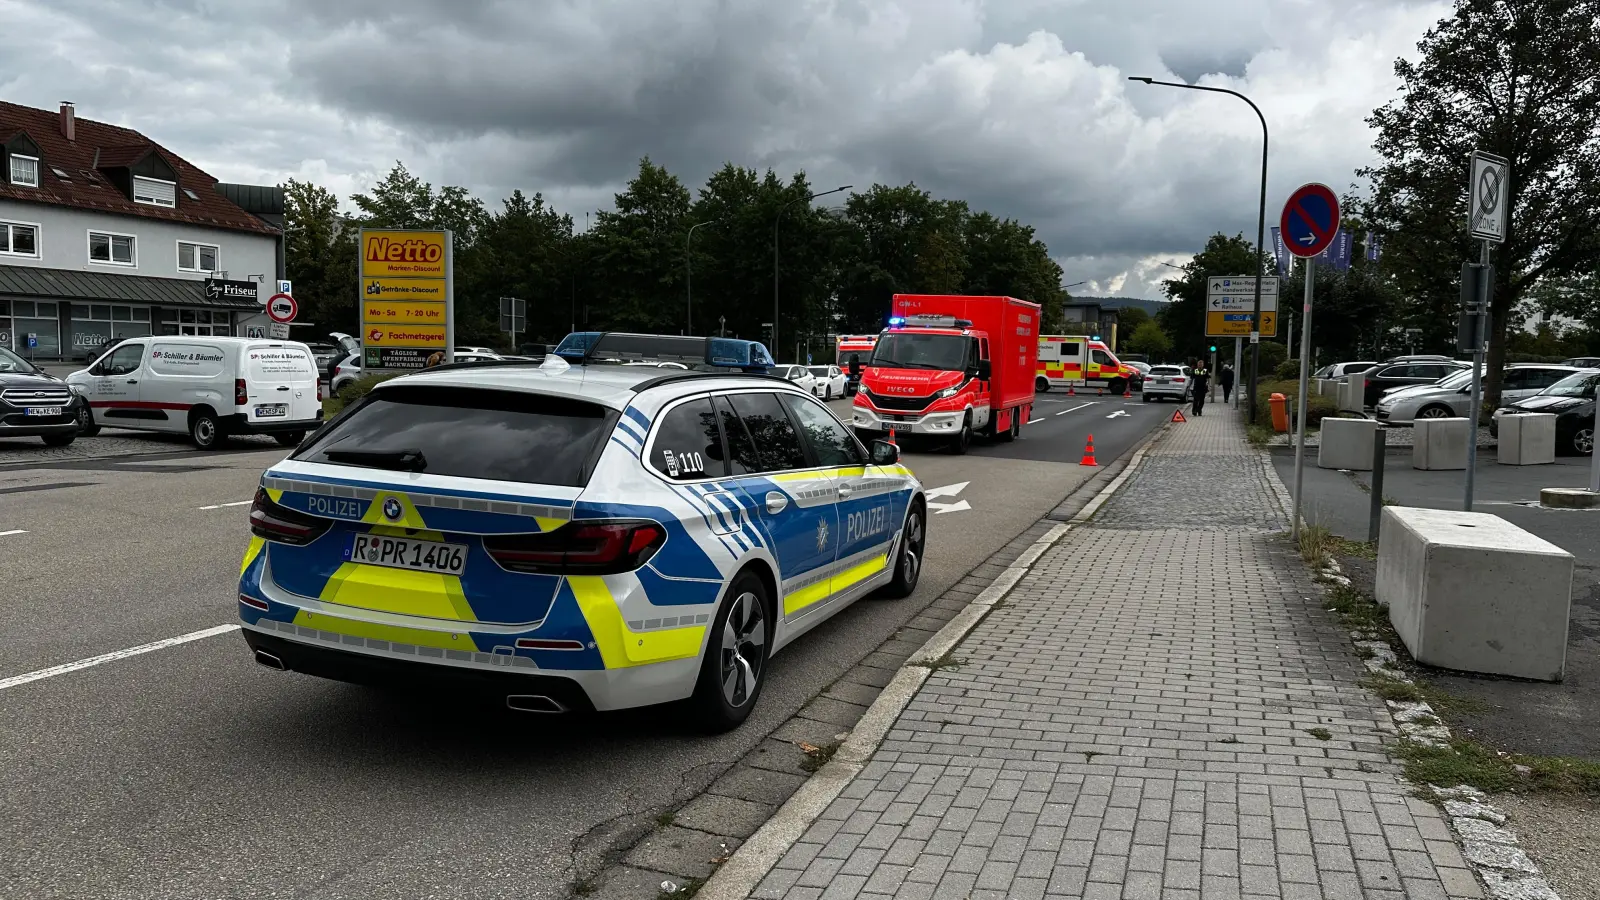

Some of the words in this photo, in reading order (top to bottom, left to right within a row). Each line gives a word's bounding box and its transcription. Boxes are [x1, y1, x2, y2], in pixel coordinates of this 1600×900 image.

[367, 237, 442, 263] Netto
[224, 284, 257, 296] Friseur
[381, 286, 439, 294] Getränke-Discount
[389, 331, 445, 341] Fachmetzgerei
[153, 351, 163, 359] SP:
[163, 351, 188, 360] Schiller
[195, 353, 224, 362] Bäumler
[886, 385, 915, 393] IVECO
[679, 451, 704, 473] 110
[308, 496, 361, 518] POLIZEI
[847, 505, 885, 543] POLIZEI
[354, 537, 368, 560] R
[380, 539, 407, 565] PR
[410, 544, 463, 571] 1406
